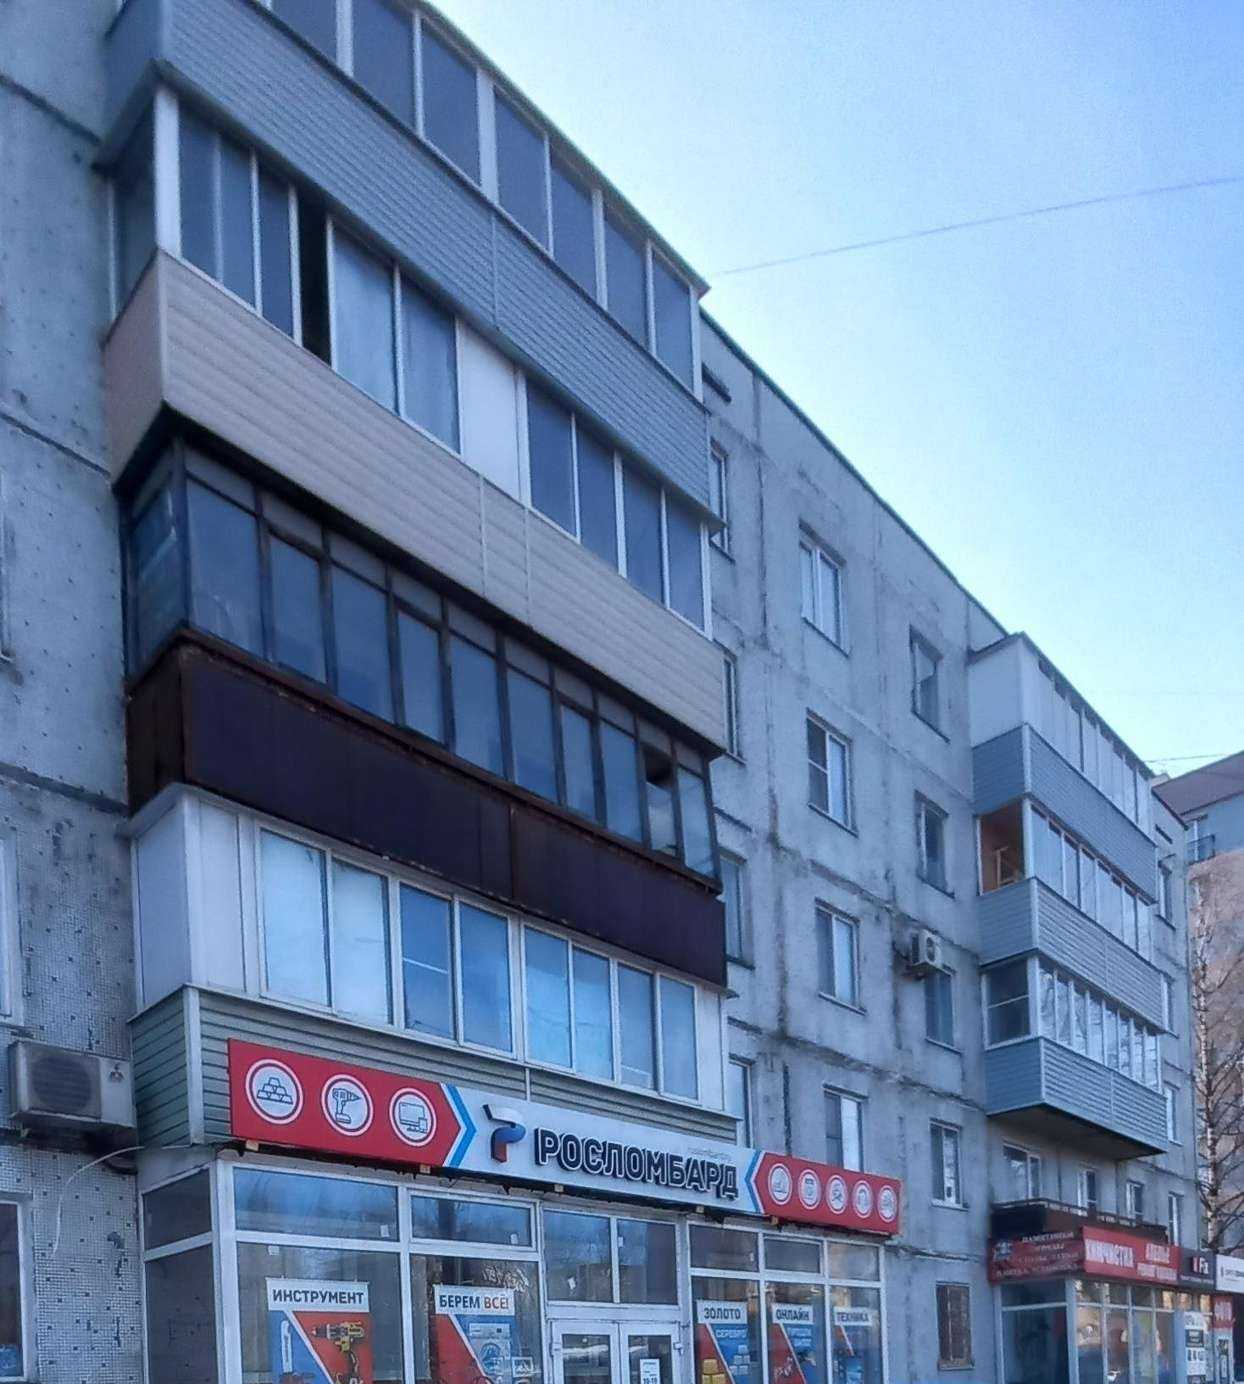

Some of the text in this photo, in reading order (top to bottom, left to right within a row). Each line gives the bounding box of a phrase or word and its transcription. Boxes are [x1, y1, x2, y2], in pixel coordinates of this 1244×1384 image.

[533, 1127, 739, 1200] РОСЛОМБАРД
[272, 1288, 364, 1305] ИНСТРУМЕНТ
[439, 1294, 480, 1309] БЕРЕМ
[703, 1307, 741, 1321] ЗОЛОТО
[775, 1306, 810, 1321] ОНЛАЙН
[836, 1311, 870, 1323] ТЕХНИКА
